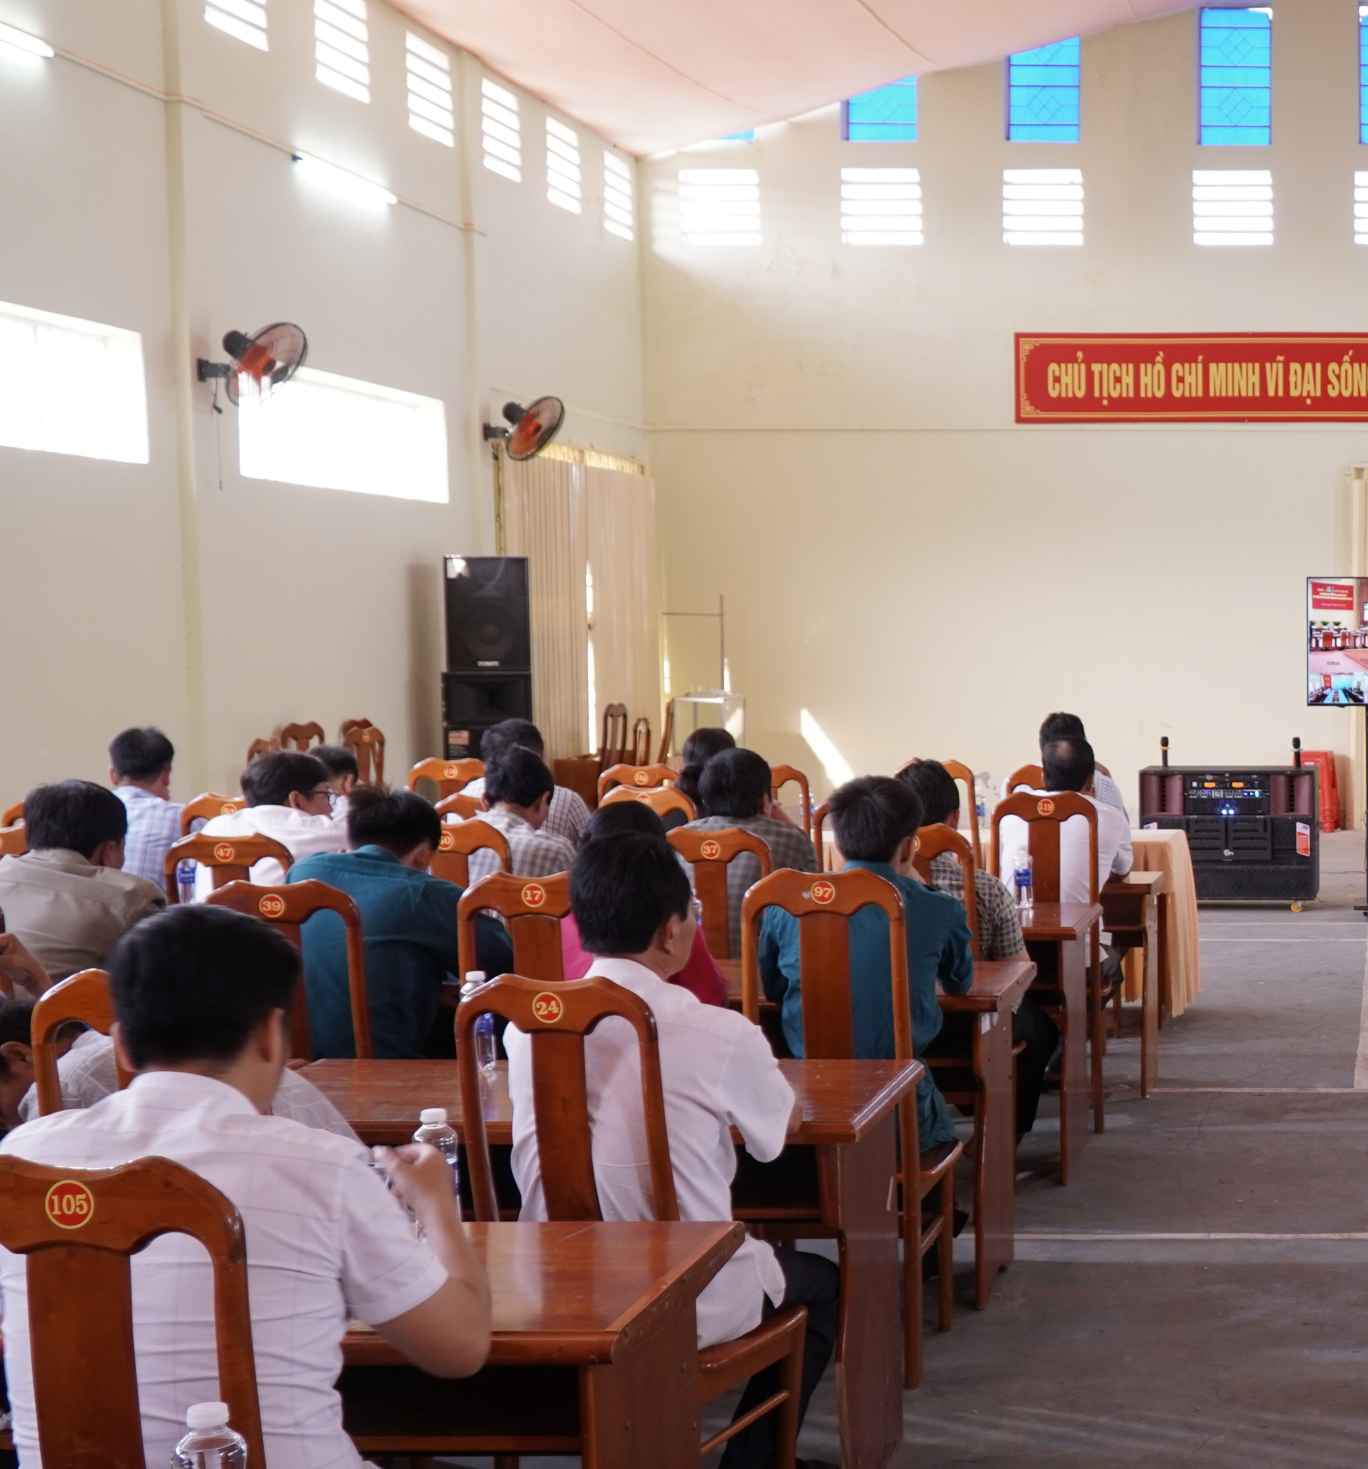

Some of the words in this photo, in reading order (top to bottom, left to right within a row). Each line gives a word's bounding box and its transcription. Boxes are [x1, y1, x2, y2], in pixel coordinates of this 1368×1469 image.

[1047, 351, 1086, 399] CHỦ
[1091, 363, 1135, 406] TỊCH
[1140, 351, 1166, 398] HỒ
[1171, 355, 1203, 398] CHÍ
[1209, 362, 1260, 397] MINH
[1265, 355, 1284, 397] VĨ
[1289, 362, 1322, 405] ĐẠI
[526, 891, 541, 900] 17
[814, 888, 832, 897] 97
[262, 901, 280, 911] 39
[536, 1002, 559, 1015] 24
[51, 1194, 89, 1216] 105
